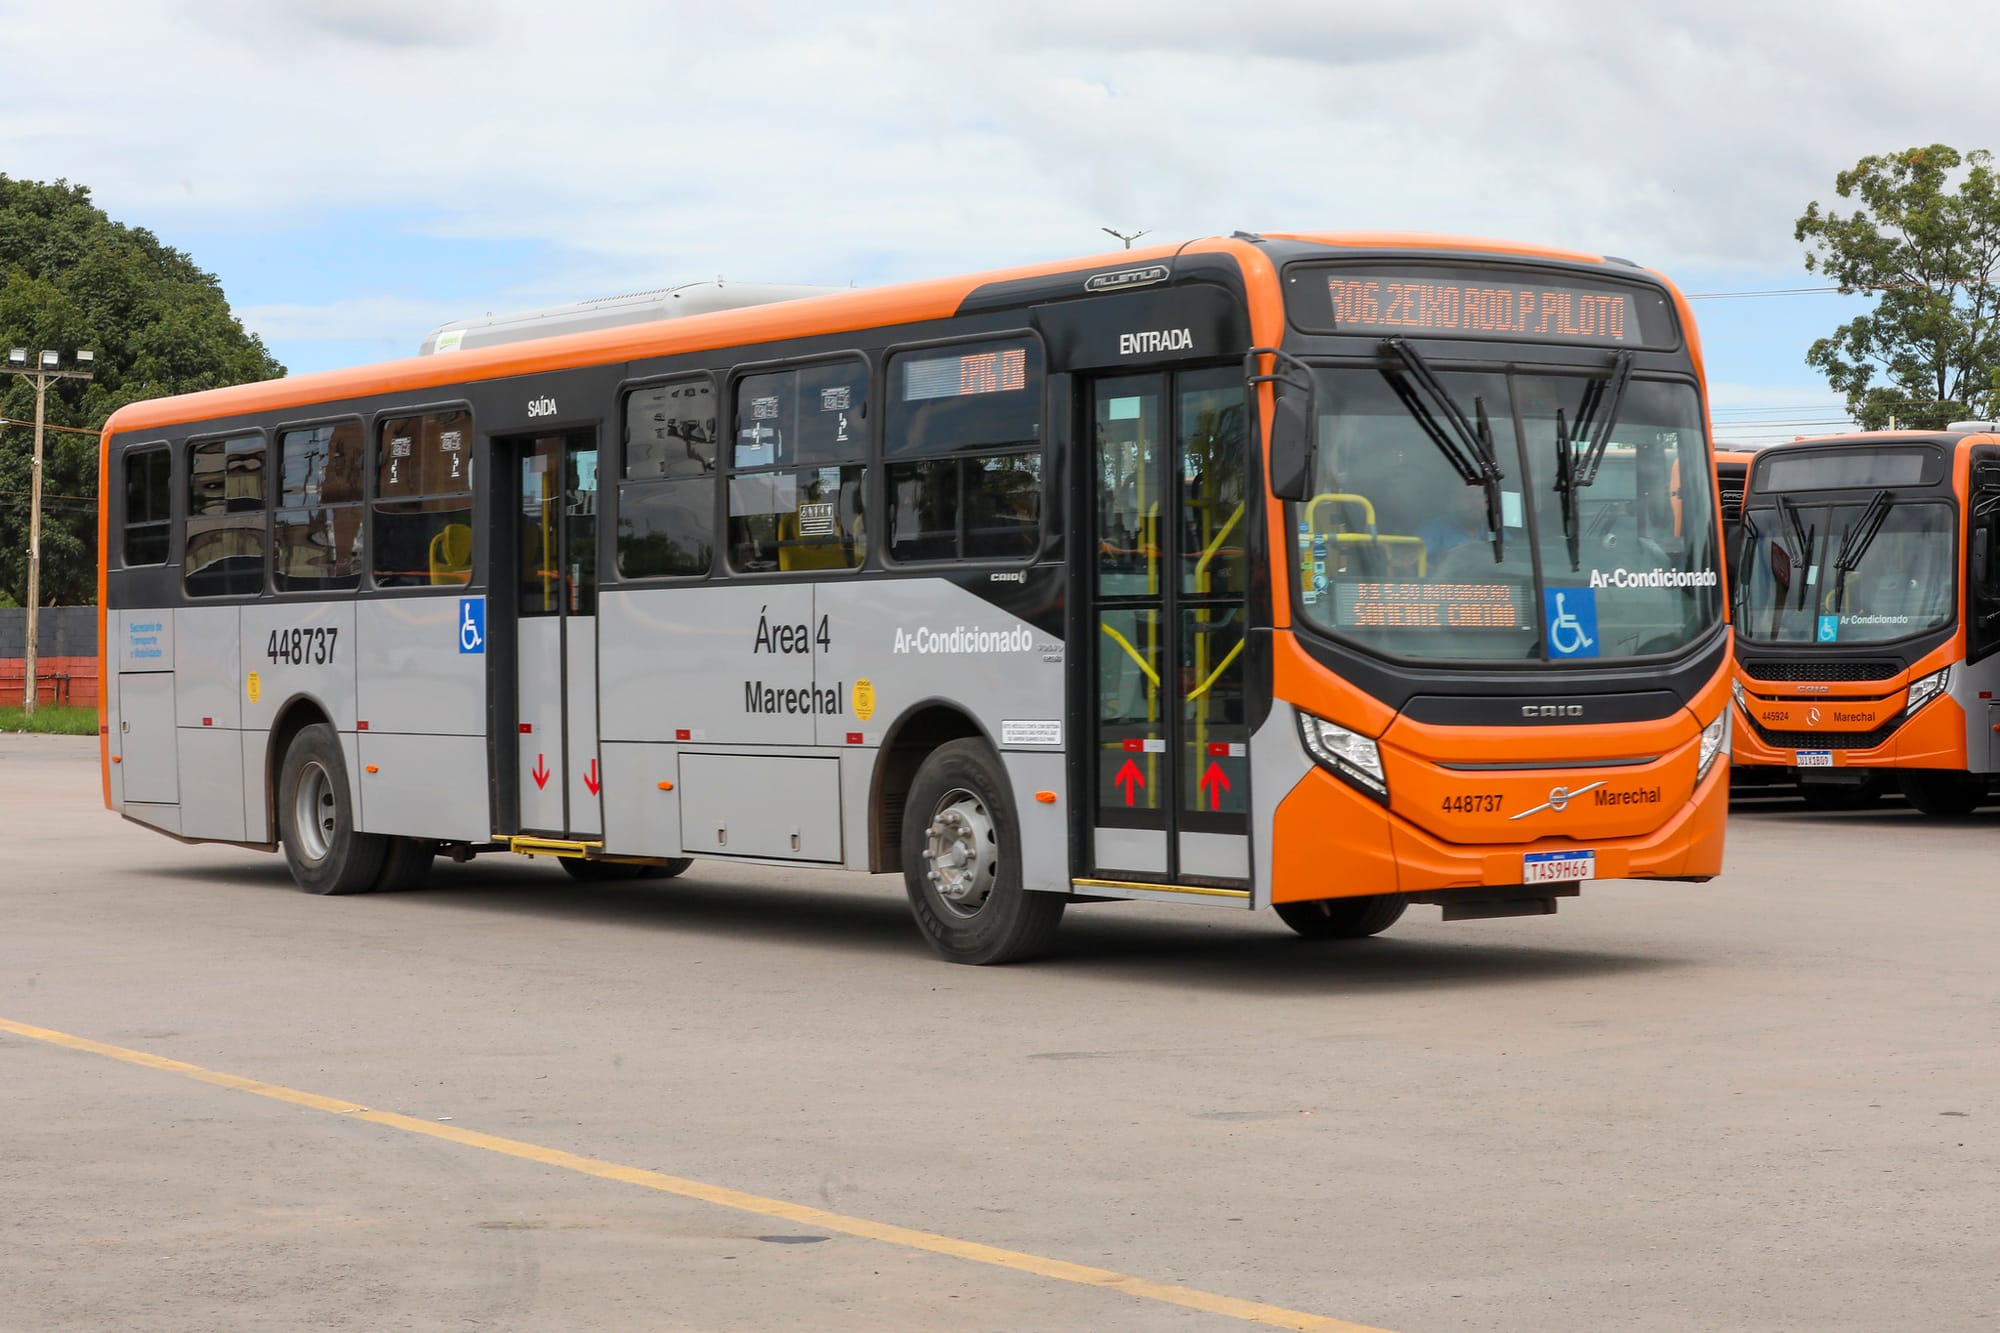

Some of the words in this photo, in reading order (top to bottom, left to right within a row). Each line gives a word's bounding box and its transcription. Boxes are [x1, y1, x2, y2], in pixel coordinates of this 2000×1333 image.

[1119, 327, 1194, 355] ENTRADA
[527, 395, 557, 418] SAÍDA
[1589, 567, 1717, 589] Ar-Condicionado
[753, 604, 810, 654] Área
[815, 613, 832, 654] 4
[1851, 613, 1909, 625] Condicionado
[267, 627, 339, 665] 448737
[893, 623, 1033, 654] Ar-Condicionado
[744, 680, 844, 715] Marechal
[1521, 705, 1584, 718] CAIO
[1833, 710, 1877, 723] Marechal
[1441, 793, 1504, 814] 448737
[1594, 786, 1661, 807] Marechal
[1531, 859, 1589, 881] TAS9H66
